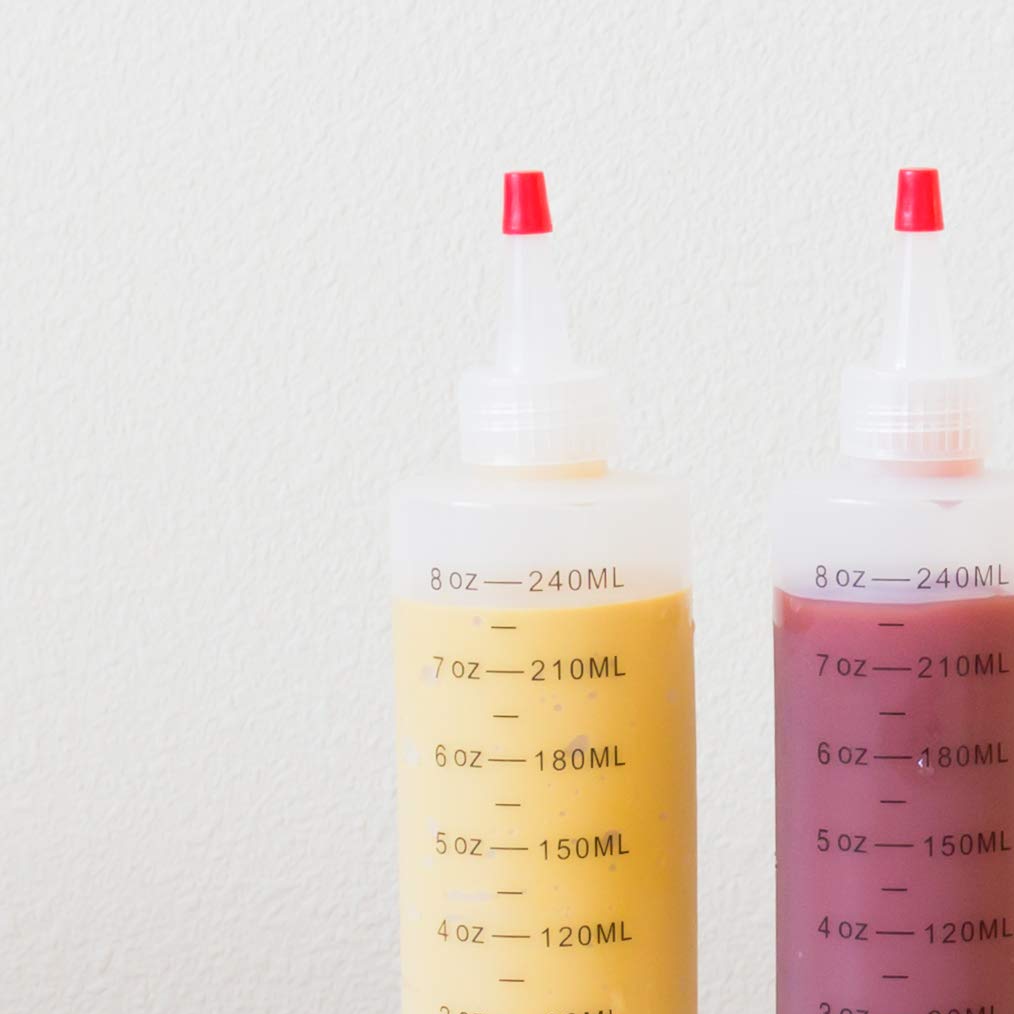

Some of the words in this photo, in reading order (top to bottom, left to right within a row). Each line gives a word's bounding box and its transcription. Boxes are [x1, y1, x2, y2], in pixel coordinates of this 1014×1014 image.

[528, 566, 625, 593] 240ML
[916, 563, 1010, 590] 240ML
[530, 655, 627, 682] 210ML
[917, 651, 1011, 679] 210ML
[534, 744, 626, 772] 180ML
[920, 741, 1009, 769] 180ML
[539, 832, 630, 861] 150ML
[923, 829, 1012, 858] 150ML
[541, 920, 633, 948] 120ML
[923, 917, 1014, 945] 120ML
